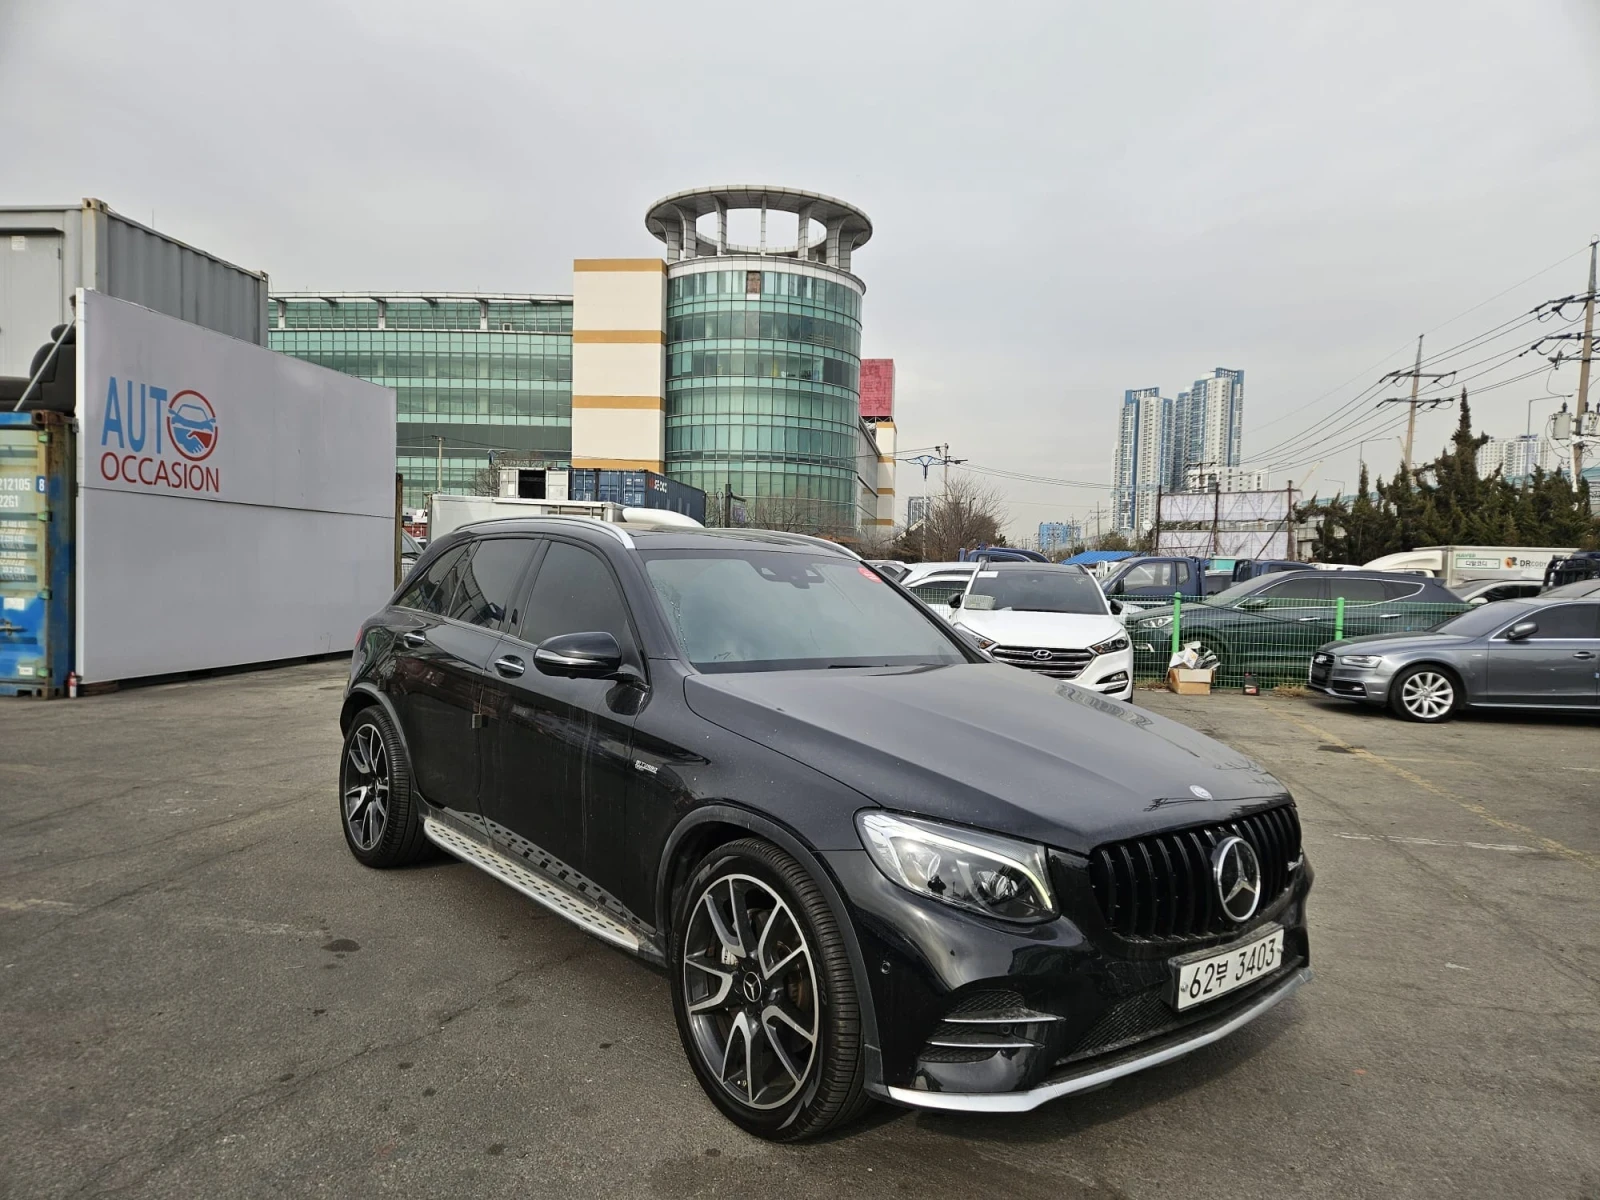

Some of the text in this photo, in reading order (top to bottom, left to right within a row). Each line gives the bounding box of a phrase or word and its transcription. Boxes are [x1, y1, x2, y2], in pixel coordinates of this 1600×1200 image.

[38, 478, 45, 492] 8
[100, 451, 219, 493] OCCASION
[1189, 938, 1276, 999] 62부 3403
